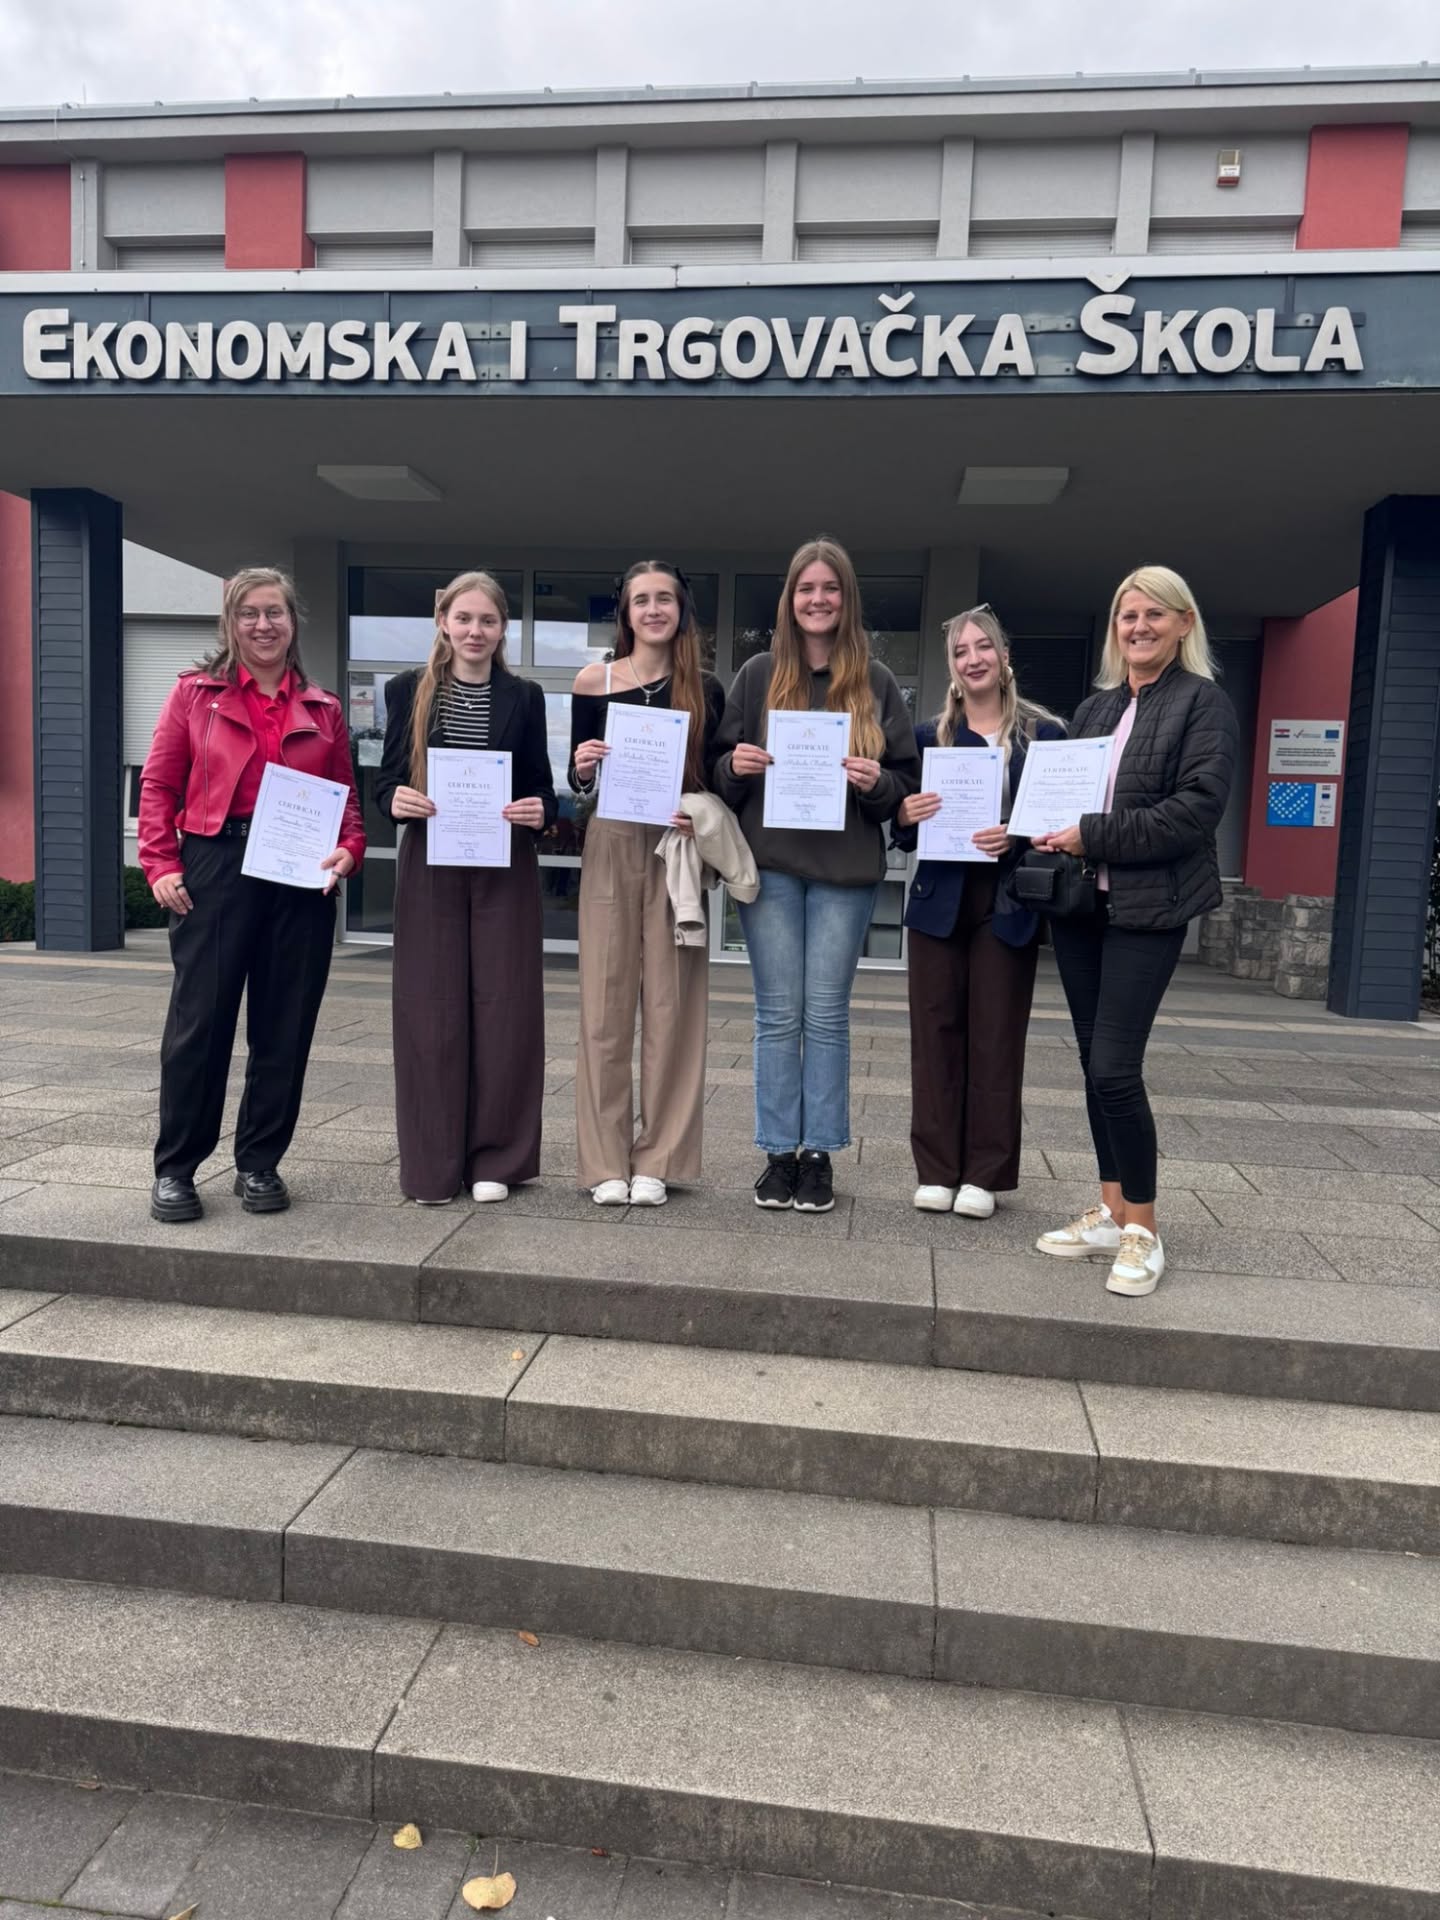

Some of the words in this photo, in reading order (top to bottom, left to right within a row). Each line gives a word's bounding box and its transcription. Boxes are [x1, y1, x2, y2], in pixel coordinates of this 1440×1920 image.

[22, 307, 477, 381] EKONOMSKA
[510, 319, 528, 381] I
[558, 290, 1037, 381] TRGOVAČKA
[1075, 271, 1364, 376] ŠKOLA
[786, 743, 830, 751] CERTIFICATE
